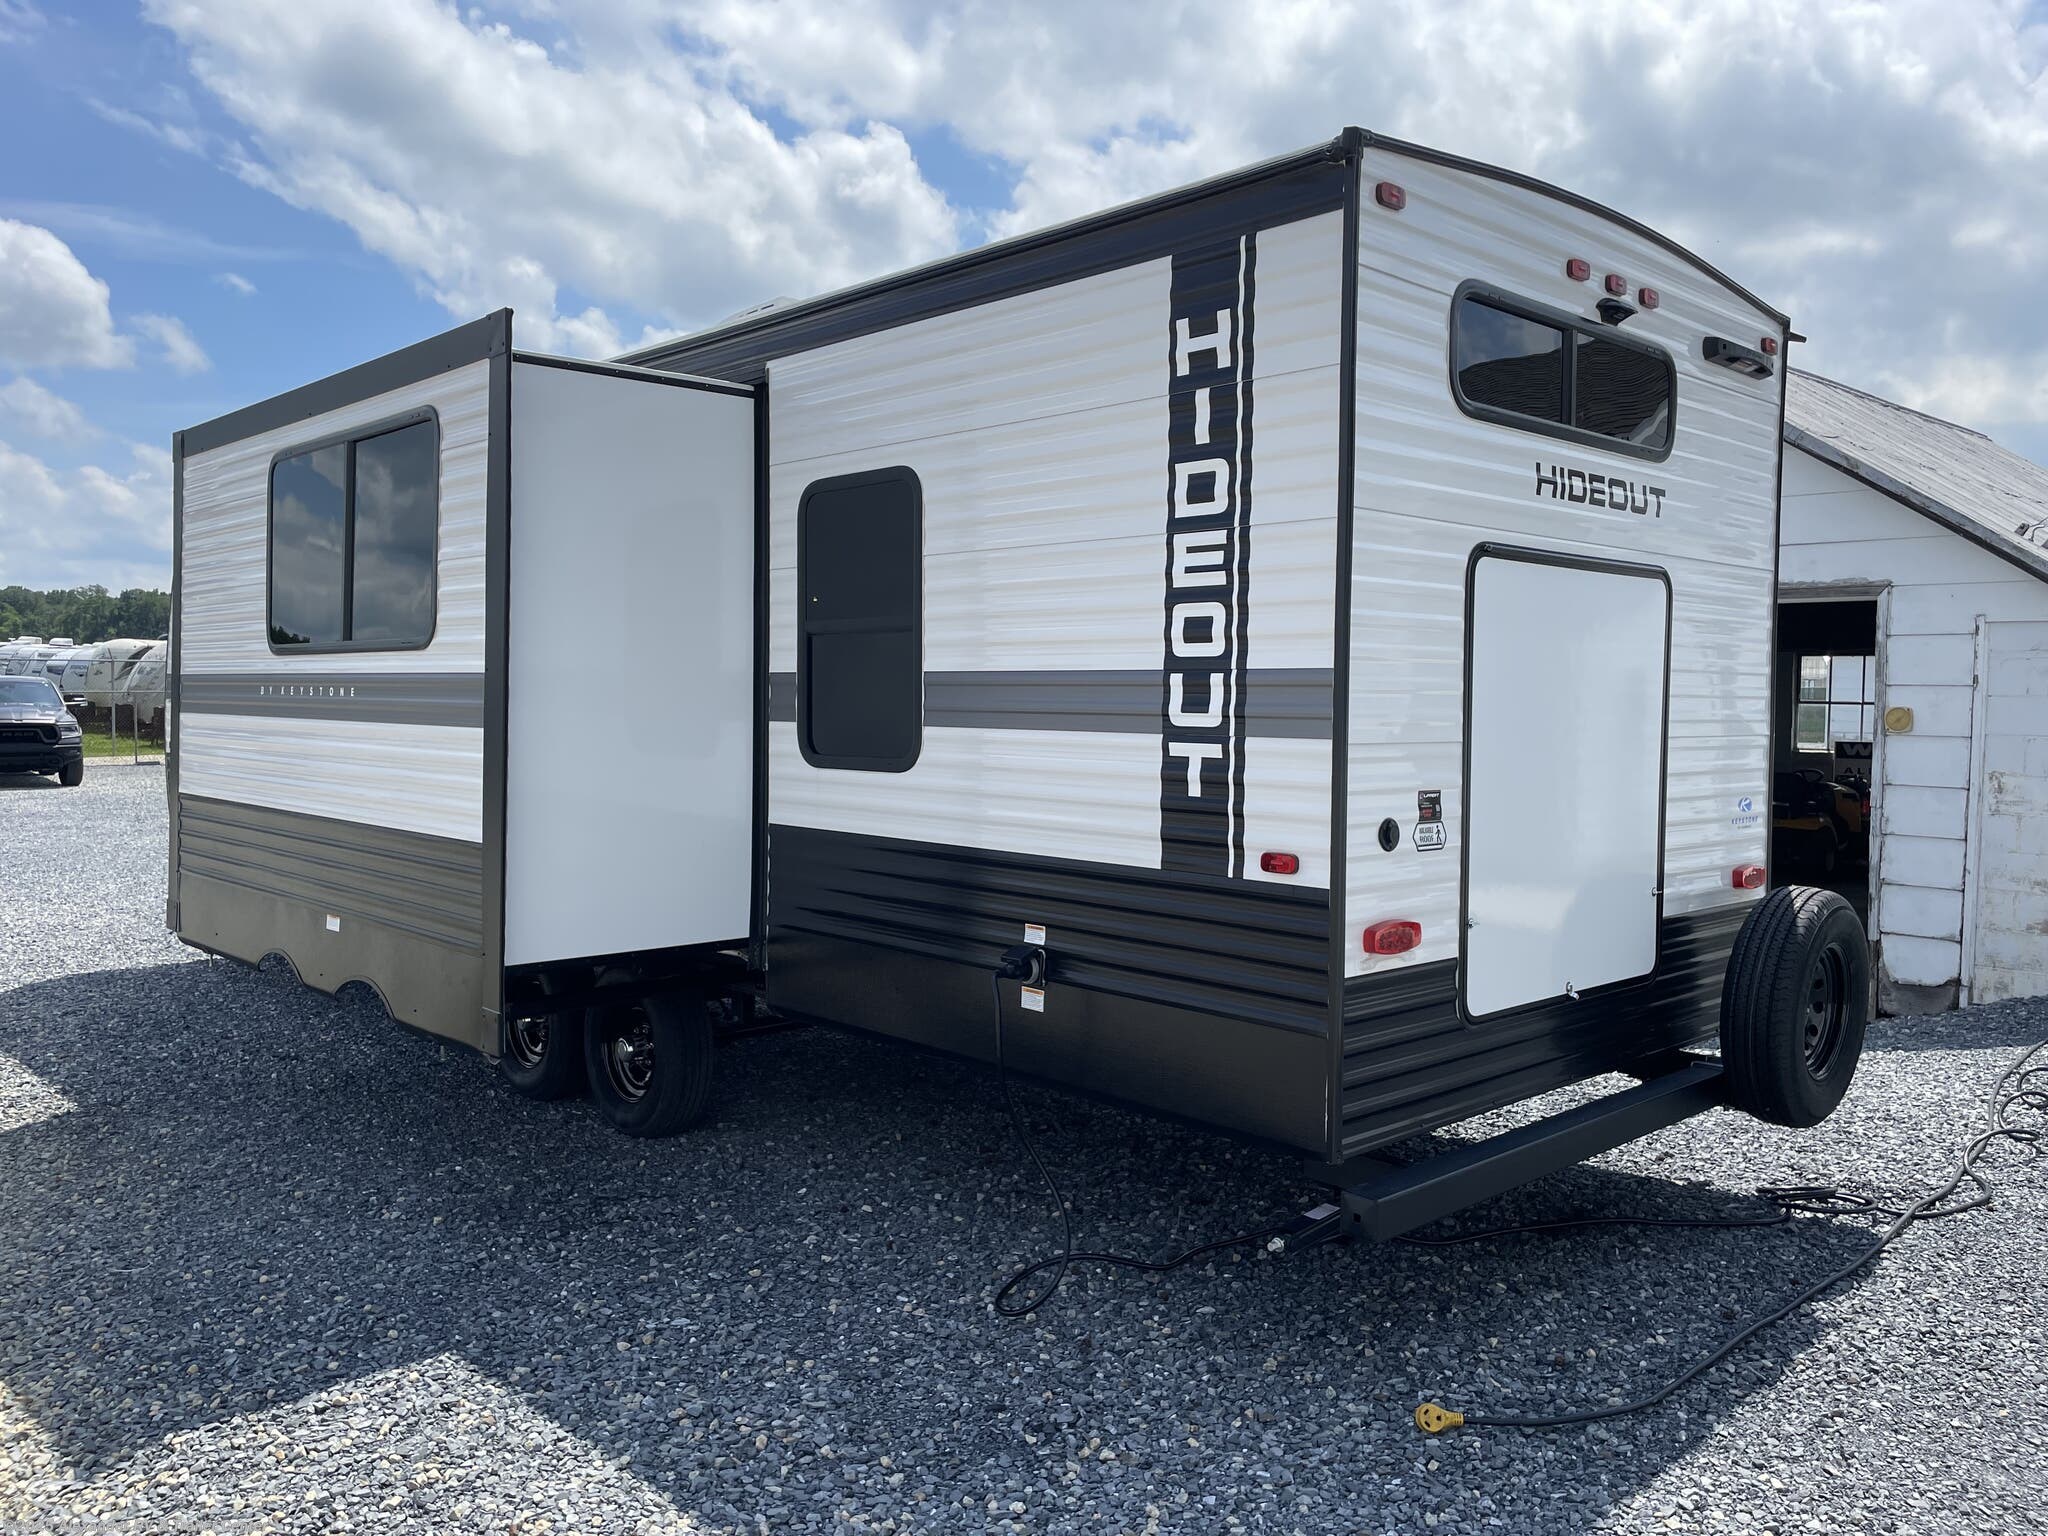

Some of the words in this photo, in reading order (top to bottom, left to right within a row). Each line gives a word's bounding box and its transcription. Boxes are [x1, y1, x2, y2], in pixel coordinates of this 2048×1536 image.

[1536, 462, 1666, 518] HIDEOUT
[1168, 308, 1233, 797] HIDEOUT
[260, 686, 273, 696] BY
[280, 686, 355, 697] KEYSTONE
